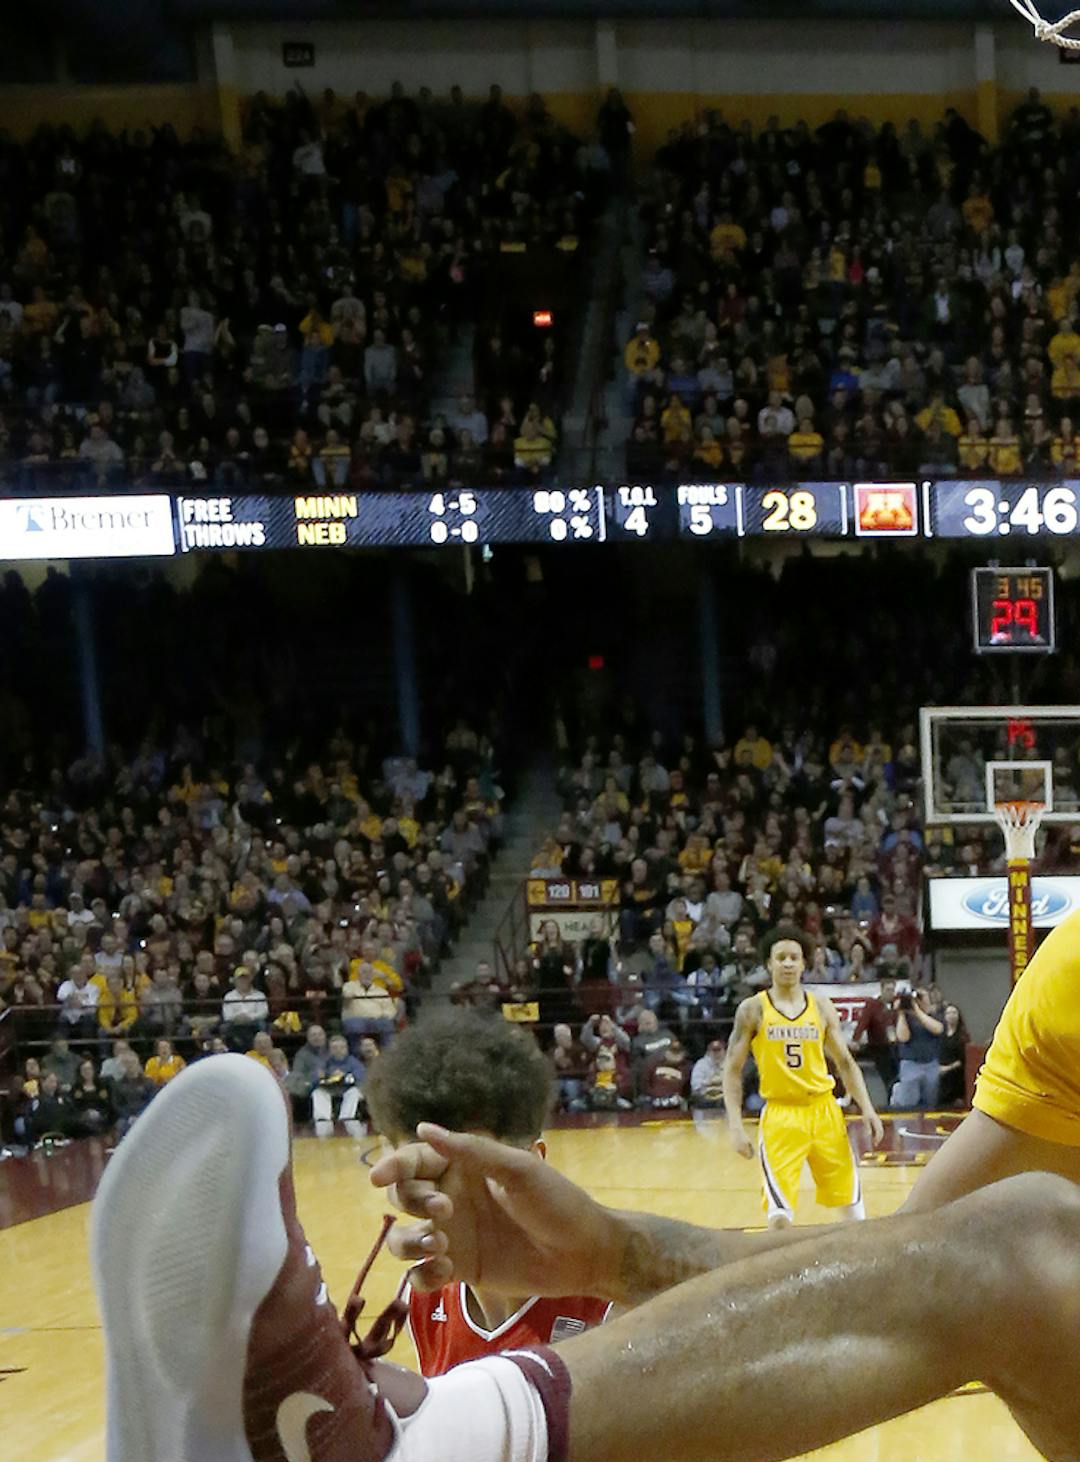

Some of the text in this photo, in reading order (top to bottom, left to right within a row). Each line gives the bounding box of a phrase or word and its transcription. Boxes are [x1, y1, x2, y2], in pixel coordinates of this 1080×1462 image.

[50, 506, 154, 531] Bremer
[182, 497, 234, 522] FREE
[294, 496, 357, 519] MINN
[690, 505, 713, 535] 5
[762, 491, 817, 530] 28
[963, 487, 1077, 535] 3:46
[624, 506, 649, 536] 4
[184, 522, 266, 547] THROWS
[297, 523, 347, 546] NEB
[991, 599, 1039, 640] 29
[767, 1026, 820, 1040] MINNESOTA
[786, 1043, 802, 1068] 5
